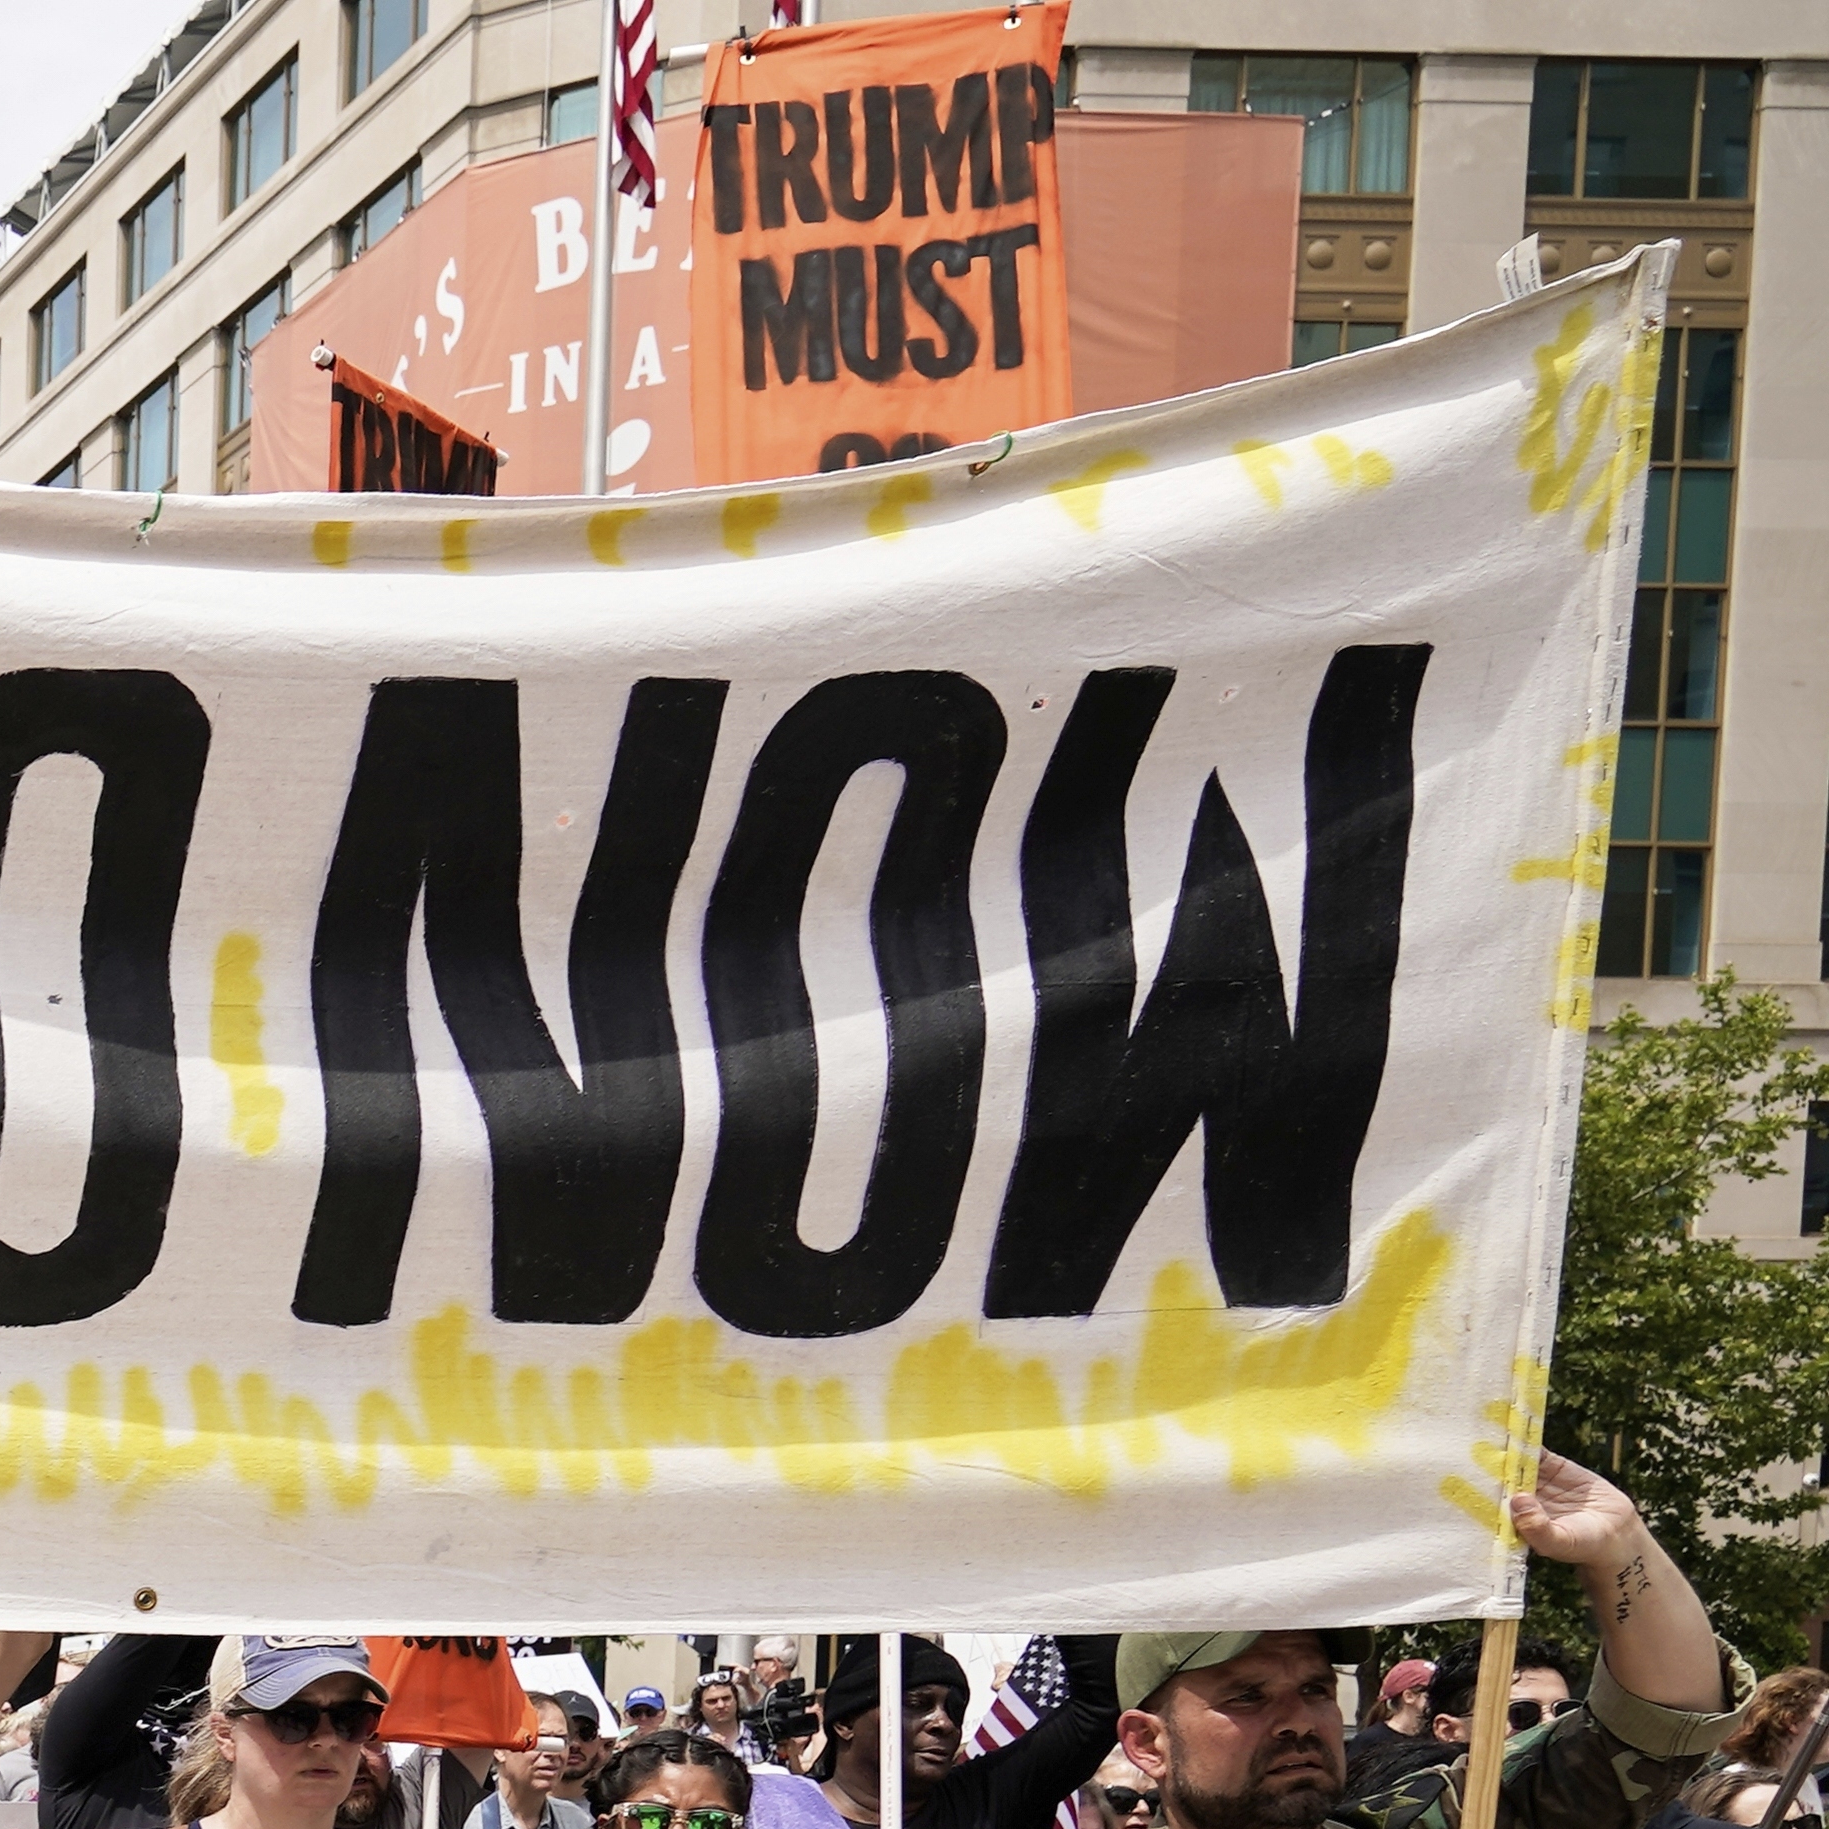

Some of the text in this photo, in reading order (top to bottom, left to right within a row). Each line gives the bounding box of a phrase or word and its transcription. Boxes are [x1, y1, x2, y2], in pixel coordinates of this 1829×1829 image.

[702, 62, 1056, 234] TRUMP
[533, 196, 692, 293] BE
[740, 223, 1040, 391] MUST
[507, 340, 583, 415] IN
[291, 643, 1434, 1337] NOW
